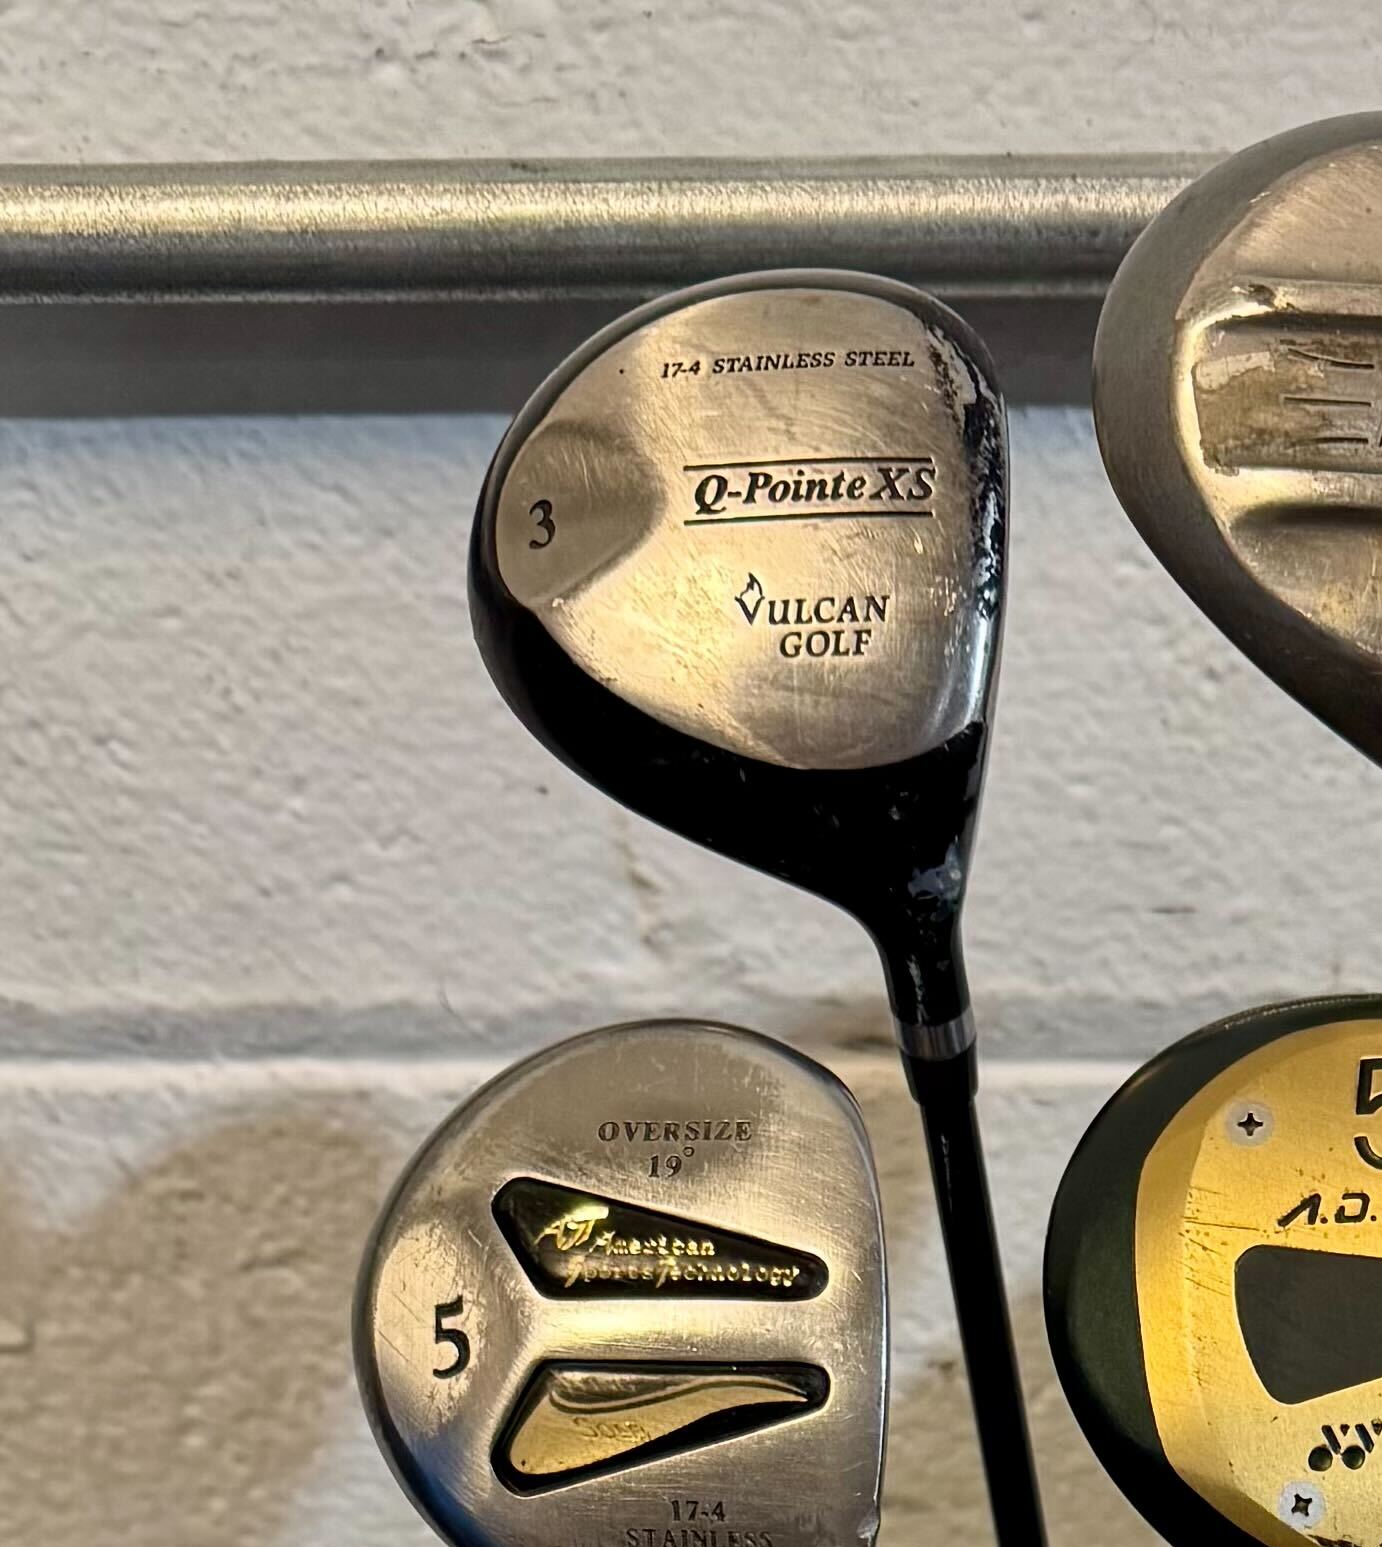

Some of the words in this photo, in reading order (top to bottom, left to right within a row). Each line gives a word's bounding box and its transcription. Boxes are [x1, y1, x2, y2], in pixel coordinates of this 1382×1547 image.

[661, 361, 701, 378] 17-4
[712, 351, 835, 374] STAINLESS
[845, 351, 915, 367] STEEL
[528, 500, 556, 549] 3
[735, 584, 890, 625] VULCAN
[780, 629, 872, 658] GOLF
[598, 1121, 752, 1142] OVERSIZE
[432, 1295, 470, 1378] 5
[671, 1500, 726, 1522] 17-4
